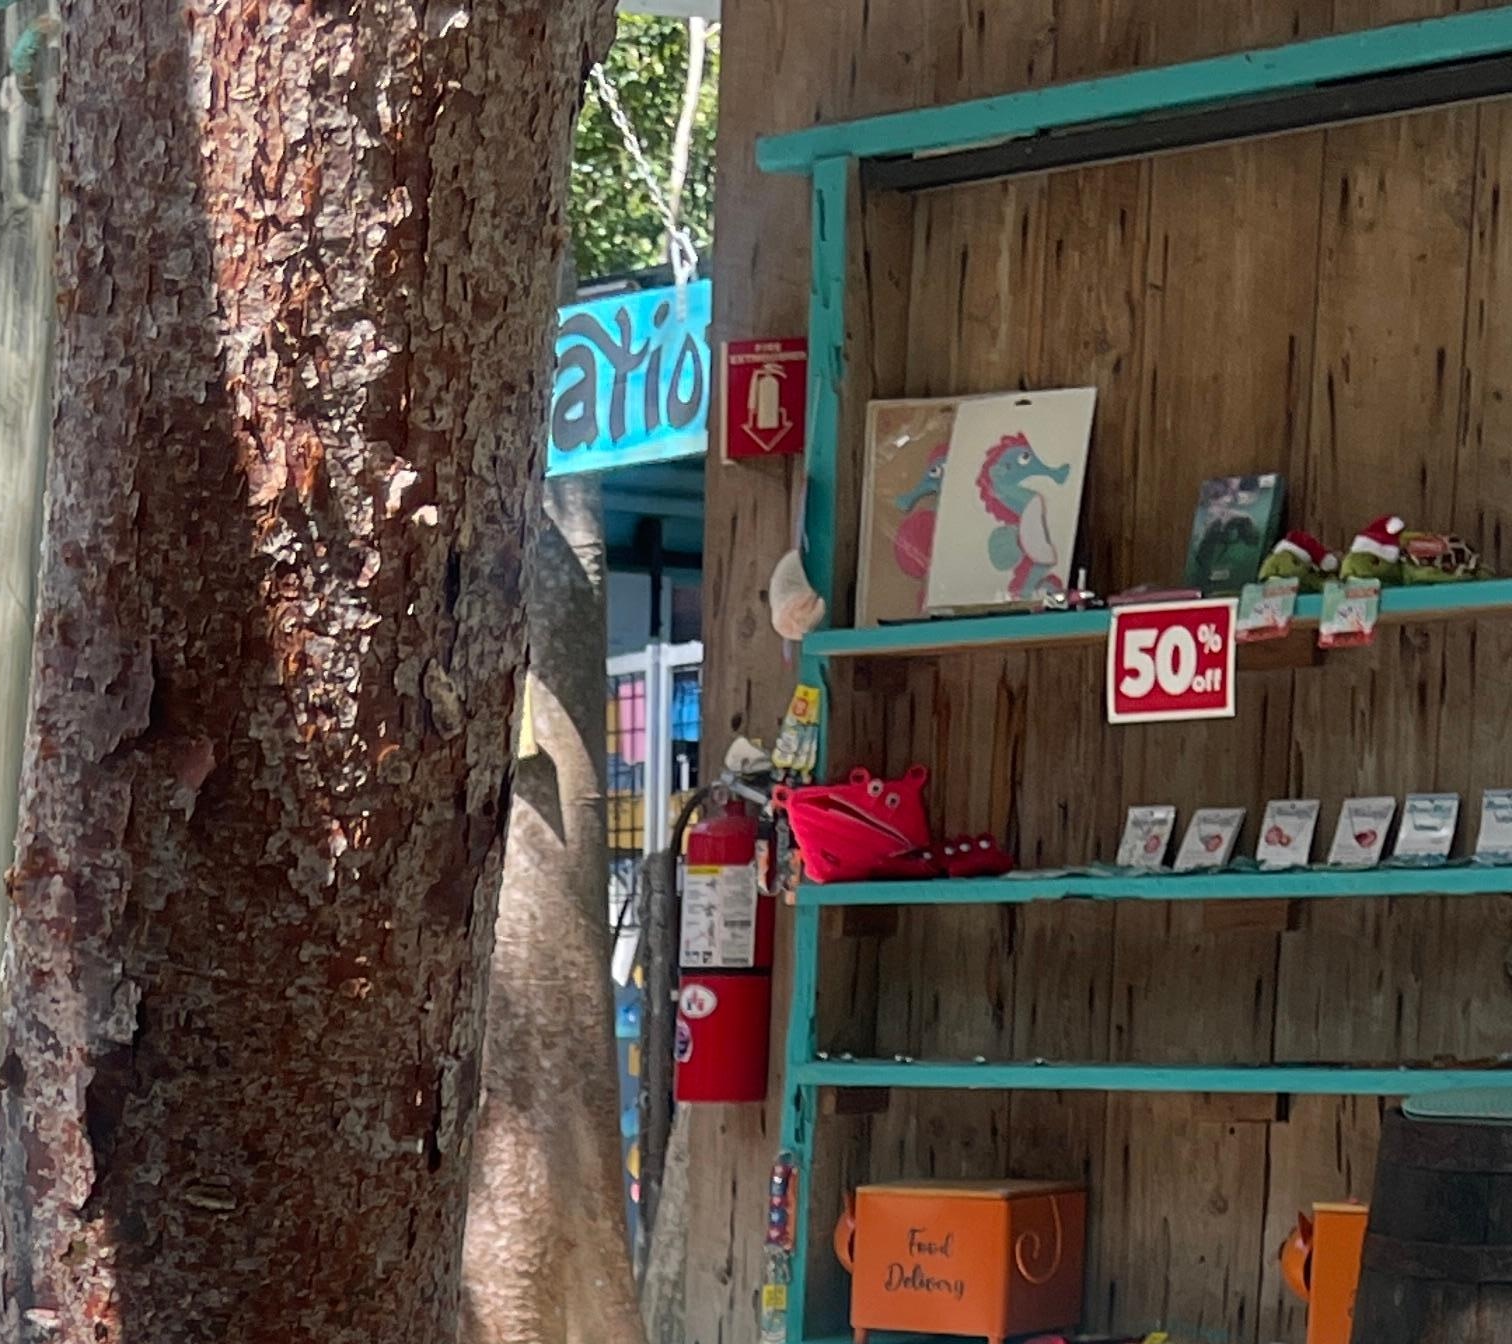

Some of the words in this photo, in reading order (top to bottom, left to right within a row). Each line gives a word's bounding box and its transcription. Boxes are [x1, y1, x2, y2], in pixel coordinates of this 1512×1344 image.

[552, 301, 703, 452] atio
[1191, 667, 1222, 693] off
[908, 1227, 954, 1257] Food
[884, 1262, 964, 1301] Delivery
